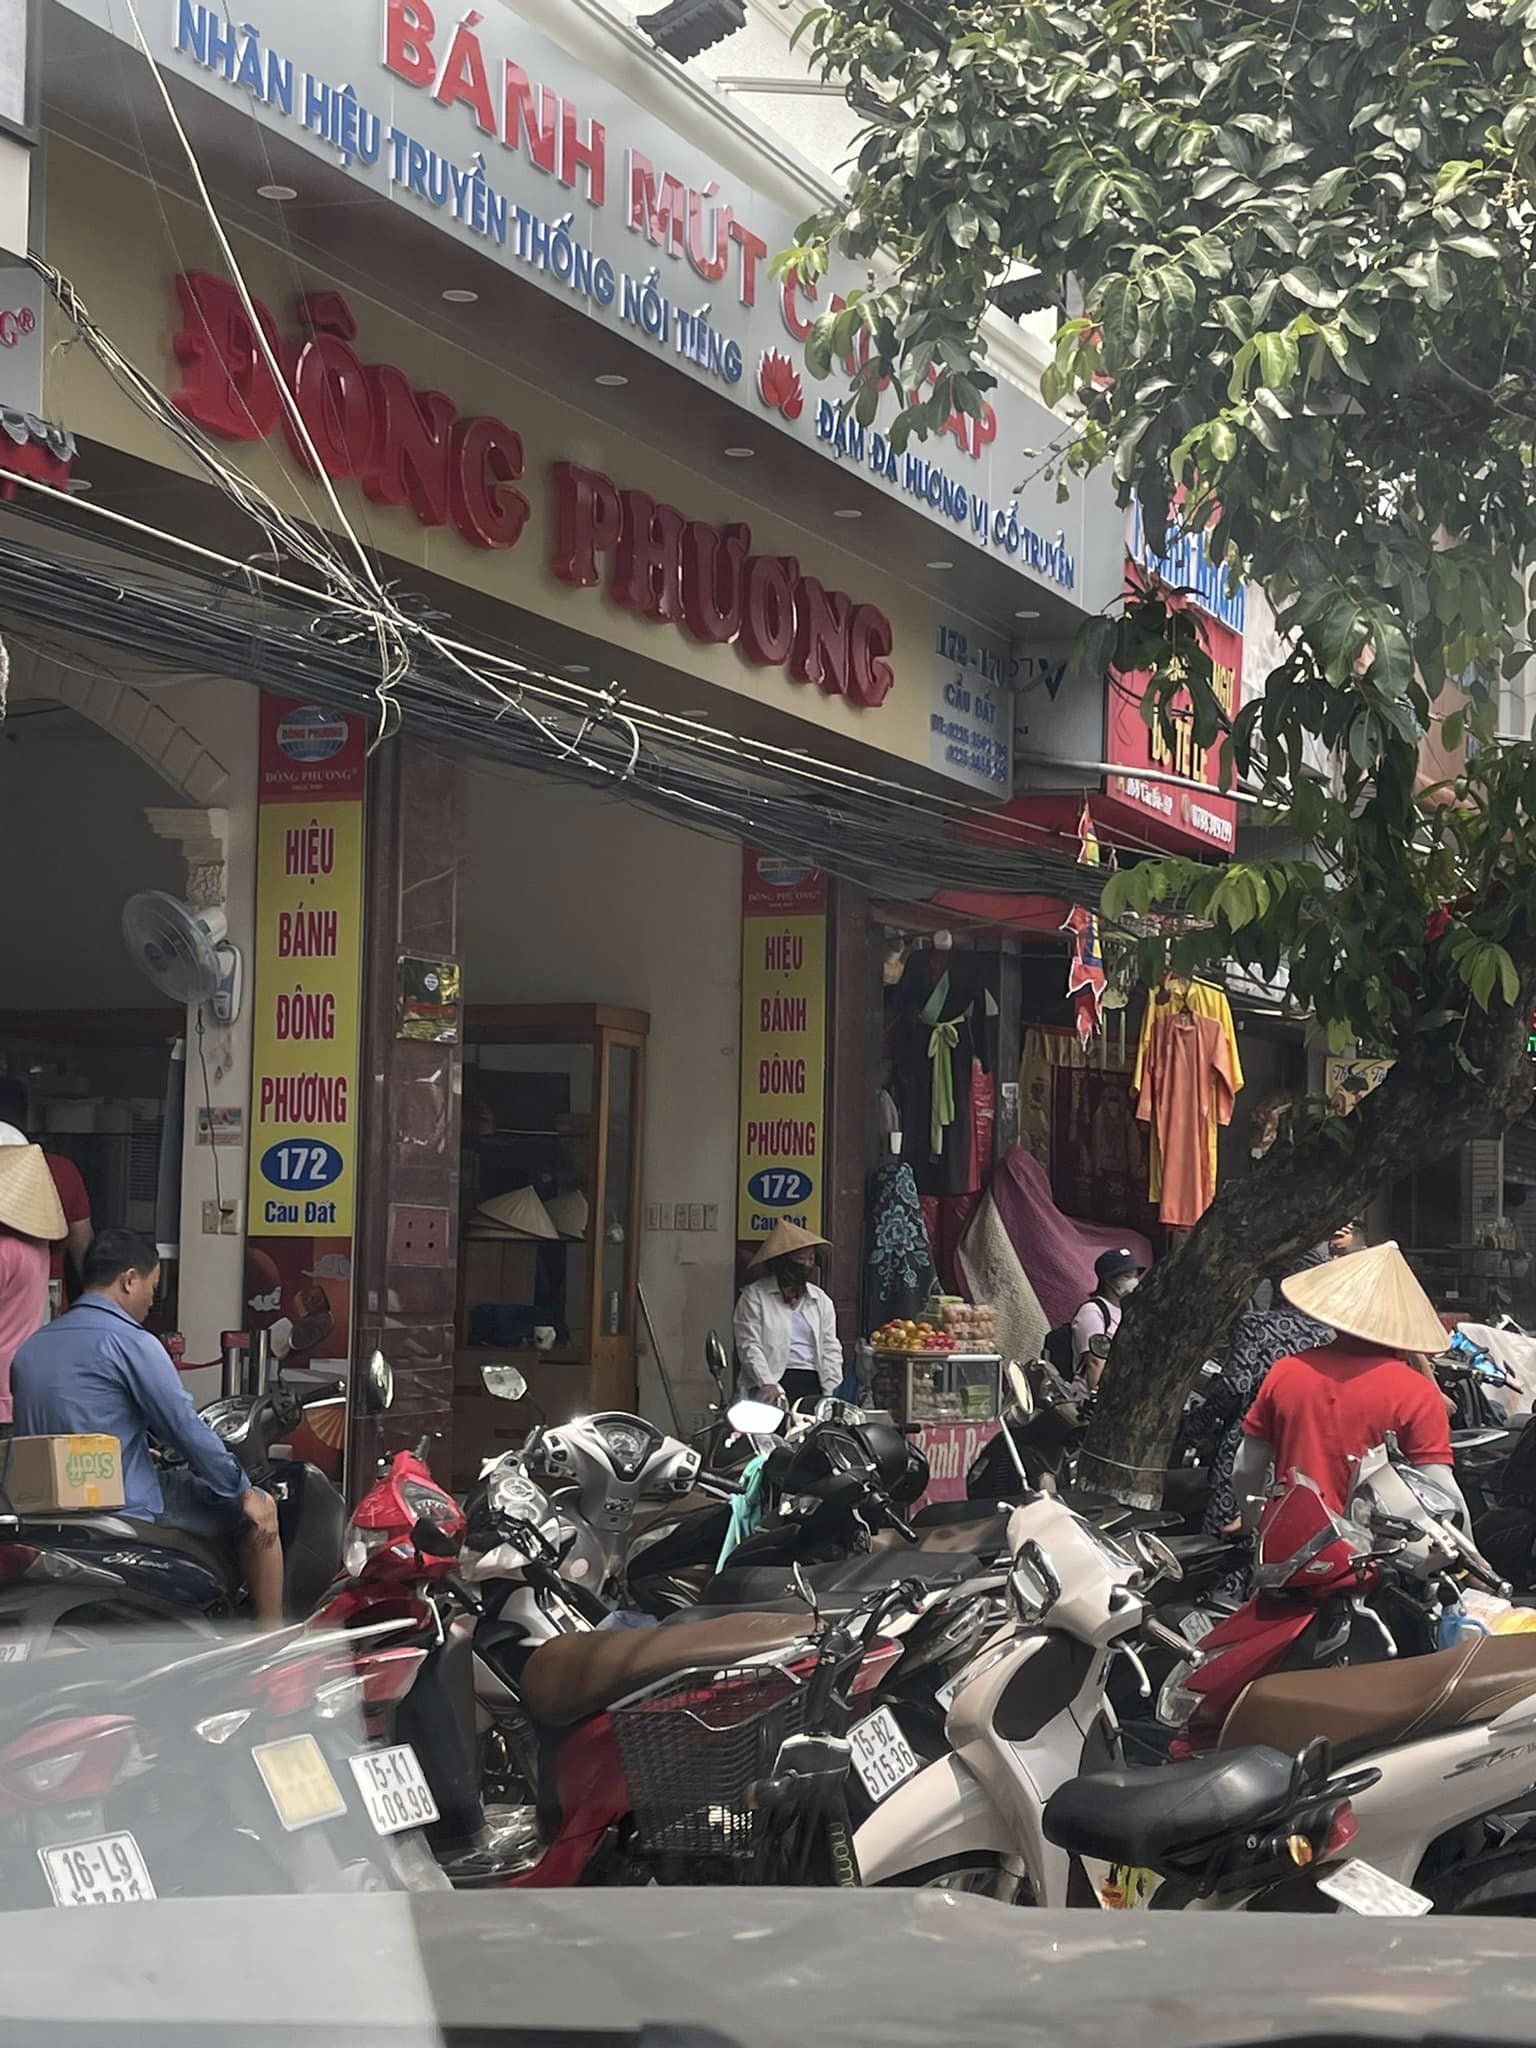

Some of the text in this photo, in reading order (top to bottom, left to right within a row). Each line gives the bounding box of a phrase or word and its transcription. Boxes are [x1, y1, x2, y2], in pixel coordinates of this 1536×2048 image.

[383, 0, 606, 206] BÁNH
[300, 71, 380, 168] HIỆU
[385, 125, 507, 244] TRUYỀN
[510, 205, 615, 306] THỐNG
[620, 266, 669, 343] NỔI
[673, 303, 744, 384] TIẾNG
[170, 268, 532, 550] ĐÔNG
[551, 459, 894, 707] PHƯƠNG
[902, 452, 969, 522] HƯƠNG
[970, 493, 989, 546] VỊ
[990, 500, 1020, 555] CỔ
[285, 818, 335, 885] HIỆU
[277, 902, 338, 959] BÁNH
[764, 928, 804, 979] HIỆU
[275, 984, 336, 1041] ĐÔNG
[759, 989, 807, 1034] BÁNH
[260, 1072, 348, 1124] PHƯƠNG
[758, 1051, 806, 1096] ĐÔNG
[746, 1119, 816, 1157] PHƯƠNG
[276, 1147, 328, 1181] 172
[759, 1172, 802, 1200] 172
[852, 1715, 895, 1761] 15-B2
[364, 1751, 413, 1791] 15-K1
[863, 1741, 914, 1795] 515.36
[371, 1785, 433, 1828] 408.98
[62, 1842, 132, 1892] 16-L9
